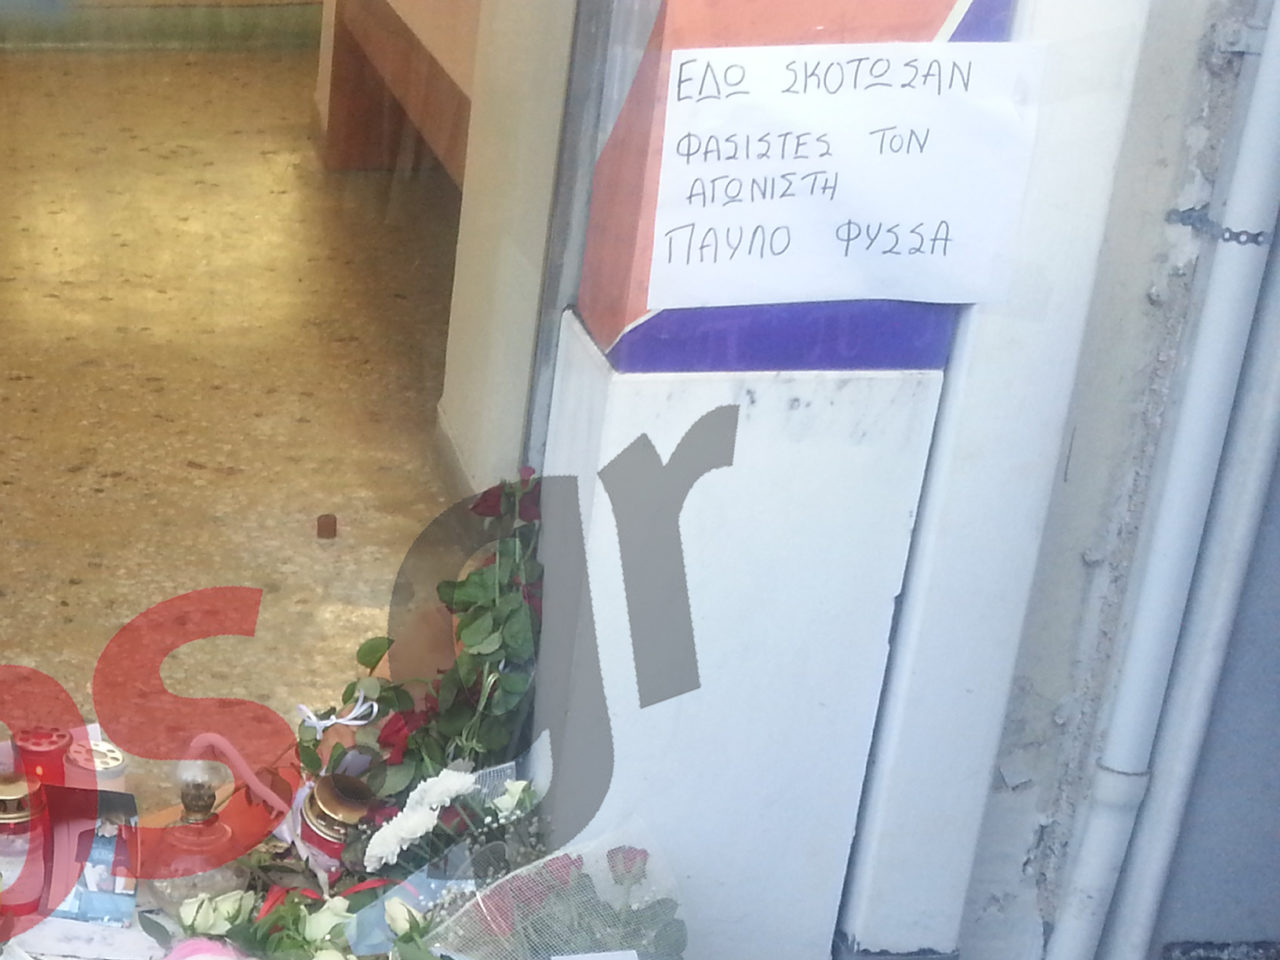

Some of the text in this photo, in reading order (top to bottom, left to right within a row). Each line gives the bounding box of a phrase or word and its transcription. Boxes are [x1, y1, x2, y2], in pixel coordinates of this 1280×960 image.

[677, 57, 972, 102] ΕΔΩ ΣΚΟΤΩΣΑΝ
[676, 126, 930, 165] ΦΑΣΙΣΤΕΣ ΤΟΝ
[685, 171, 839, 208] ΑΓΩΝΙΣΤΗ
[664, 219, 953, 265] ΠΑΥΛΟ ΦΥΣΣΑ
